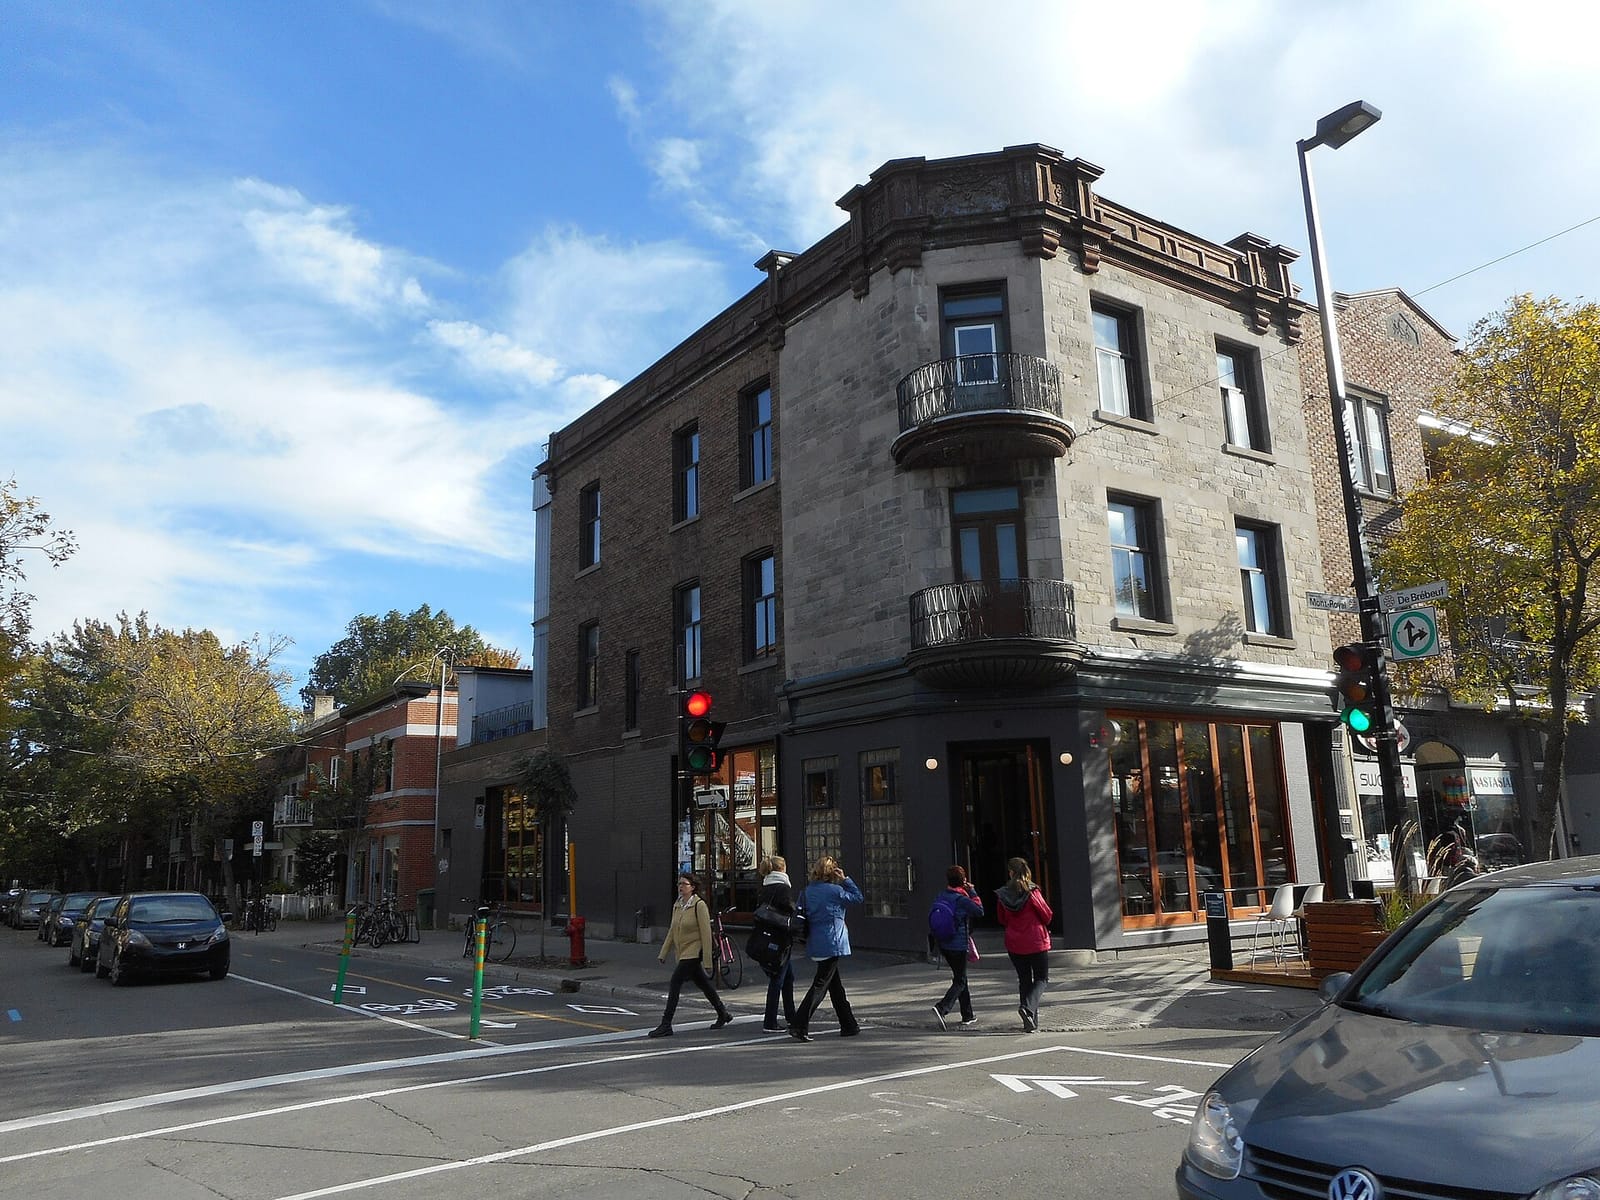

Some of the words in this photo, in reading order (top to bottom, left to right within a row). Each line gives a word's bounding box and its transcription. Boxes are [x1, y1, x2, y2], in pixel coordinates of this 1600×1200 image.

[1309, 597, 1347, 610] Mont-Royal
[1397, 596, 1410, 605] De
[1410, 586, 1444, 602] Brébeuf
